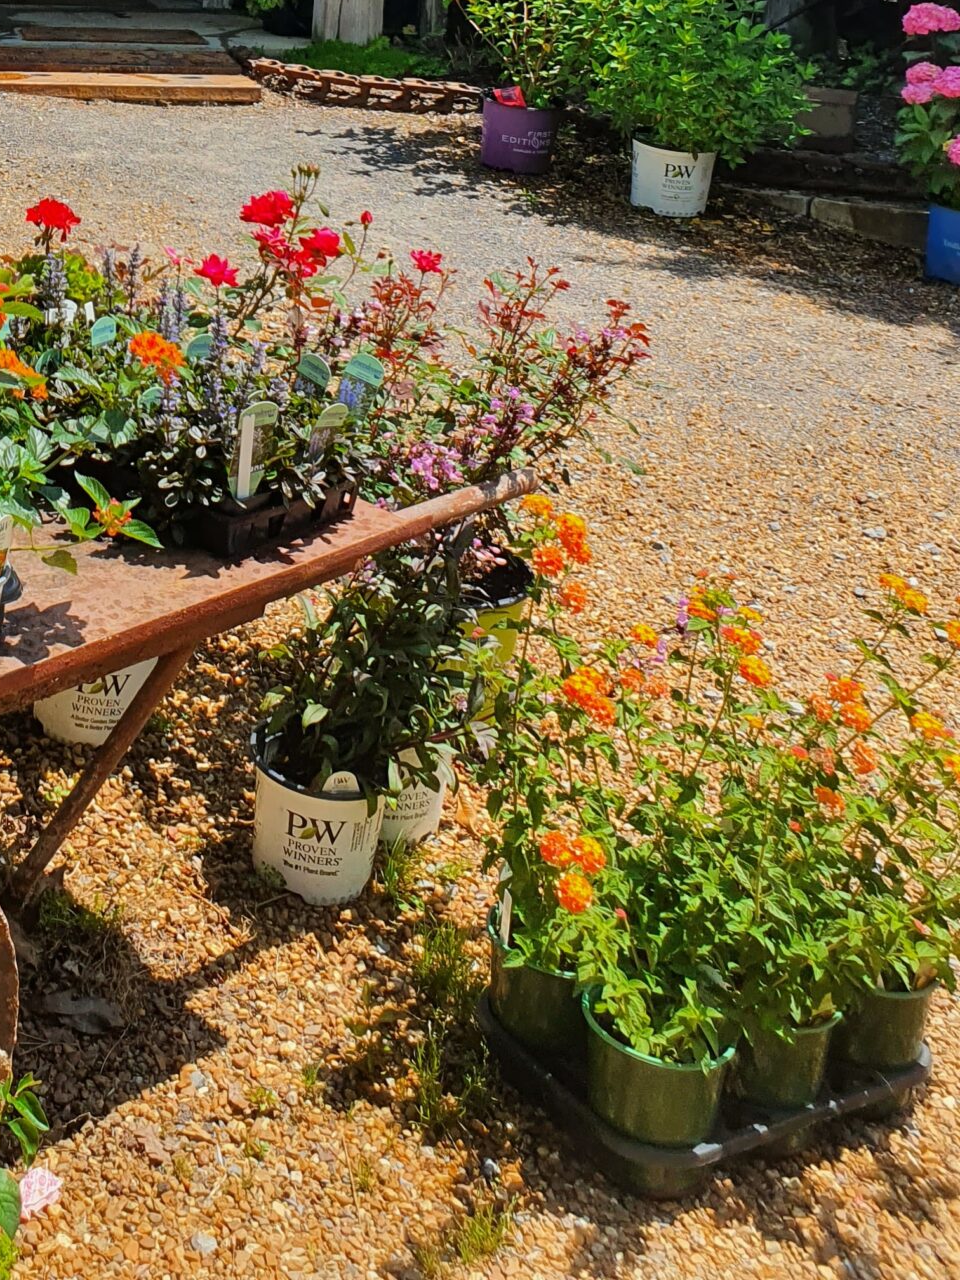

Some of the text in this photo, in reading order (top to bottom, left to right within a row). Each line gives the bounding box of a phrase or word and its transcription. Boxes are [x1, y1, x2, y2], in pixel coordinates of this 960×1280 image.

[664, 163, 696, 179] PW
[71, 702, 123, 717] WINNERS
[77, 694, 121, 708] PROVEN
[285, 809, 347, 846] PW
[288, 838, 337, 856] PROVEN
[283, 845, 340, 867] WINNERS
